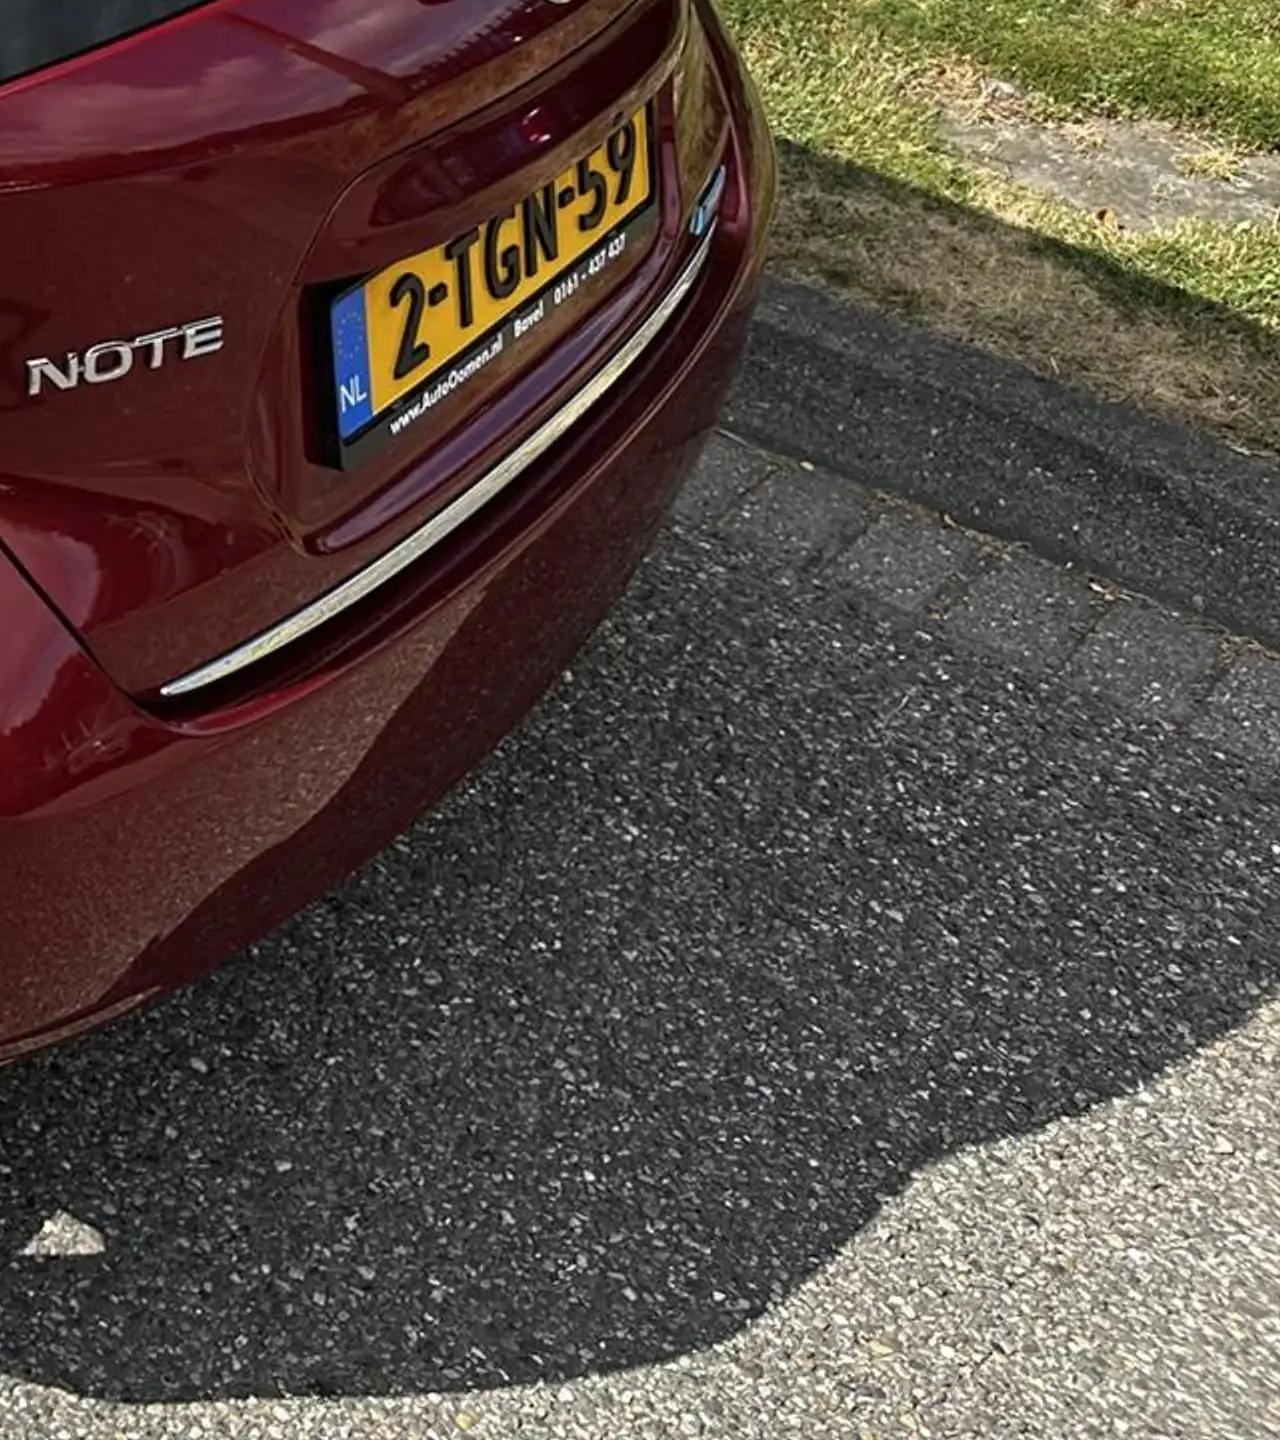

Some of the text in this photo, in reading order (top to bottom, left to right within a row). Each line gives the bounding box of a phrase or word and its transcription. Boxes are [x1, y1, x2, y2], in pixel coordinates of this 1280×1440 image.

[389, 113, 637, 380] 2-TGN-59
[26, 315, 224, 396] NOTE
[340, 375, 367, 414] NL
[390, 333, 504, 435] www.AutoOomen.nl
[513, 299, 544, 338] Bavel
